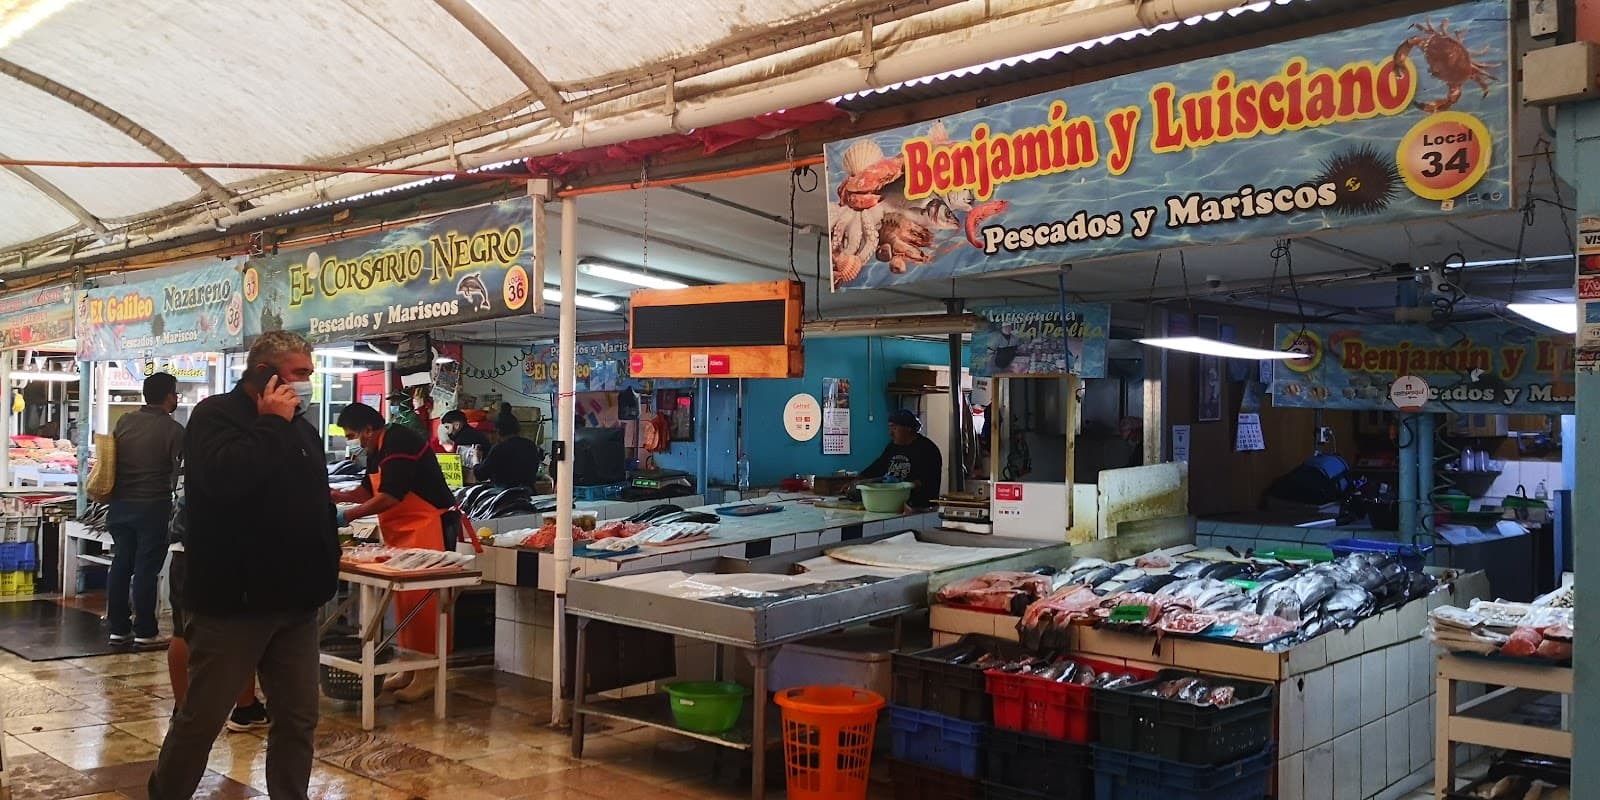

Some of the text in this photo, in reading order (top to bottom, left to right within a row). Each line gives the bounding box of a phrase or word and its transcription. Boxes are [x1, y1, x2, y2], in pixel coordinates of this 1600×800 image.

[906, 58, 1413, 196] Benjamín y Luisciano
[1423, 128, 1473, 147] Local
[1420, 148, 1470, 178] 34
[983, 183, 1337, 254] Pescados y Mariscos
[163, 279, 231, 313] Nazareno
[245, 280, 257, 297] 37
[508, 282, 524, 302] 36
[89, 299, 104, 324] El
[106, 292, 153, 322] Galileo
[228, 308, 240, 329] 38
[309, 299, 459, 335] Pescados y Mariscos
[121, 335, 154, 349] Pescados
[163, 330, 199, 345] Mariscos
[600, 341, 629, 353] Maris
[1343, 339, 1491, 377] Benjamín
[1503, 347, 1523, 378] y
[535, 362, 545, 380] El
[1387, 384, 1495, 402] cados
[1504, 388, 1520, 405] y
